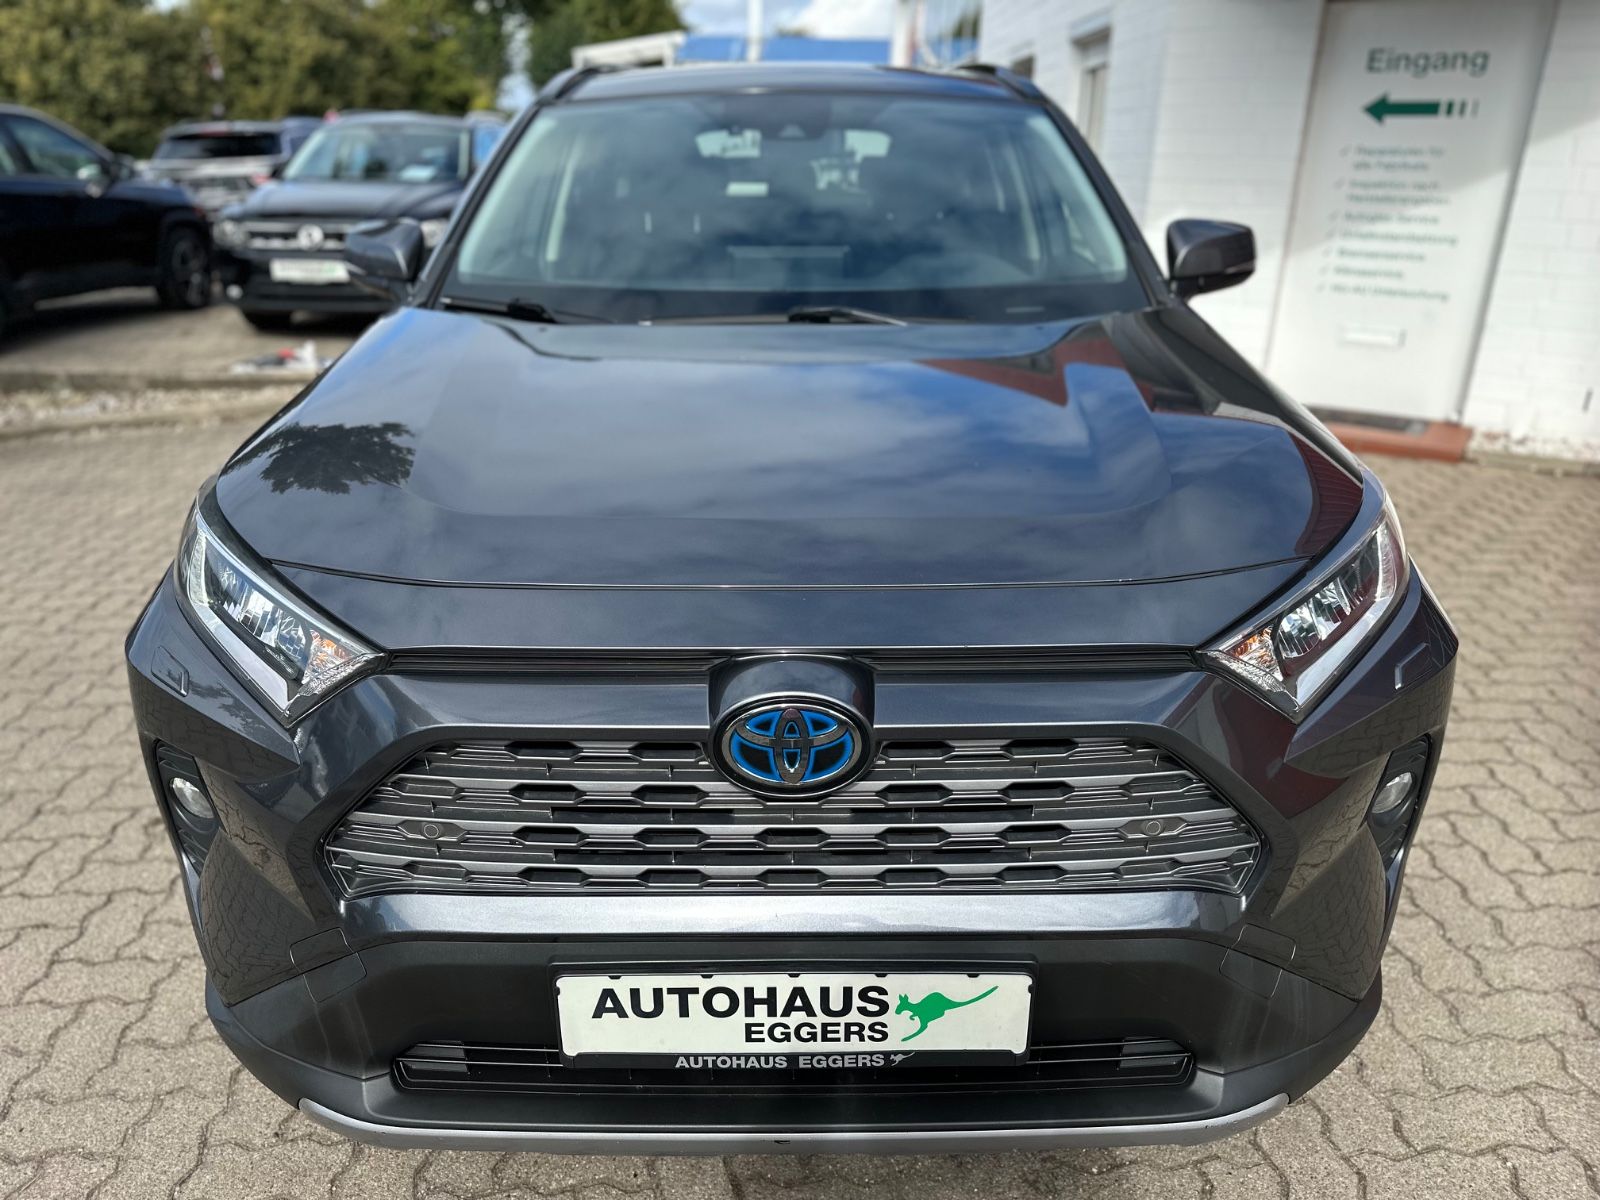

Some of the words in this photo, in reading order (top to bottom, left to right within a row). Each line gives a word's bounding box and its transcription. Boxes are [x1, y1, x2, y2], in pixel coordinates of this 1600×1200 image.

[1366, 48, 1490, 76] Eingang
[592, 986, 889, 1019] AUTOHAUS
[744, 1022, 889, 1043] EGGERS
[675, 1055, 788, 1069] AUTOHAUS
[798, 1054, 885, 1068] EGGERS
